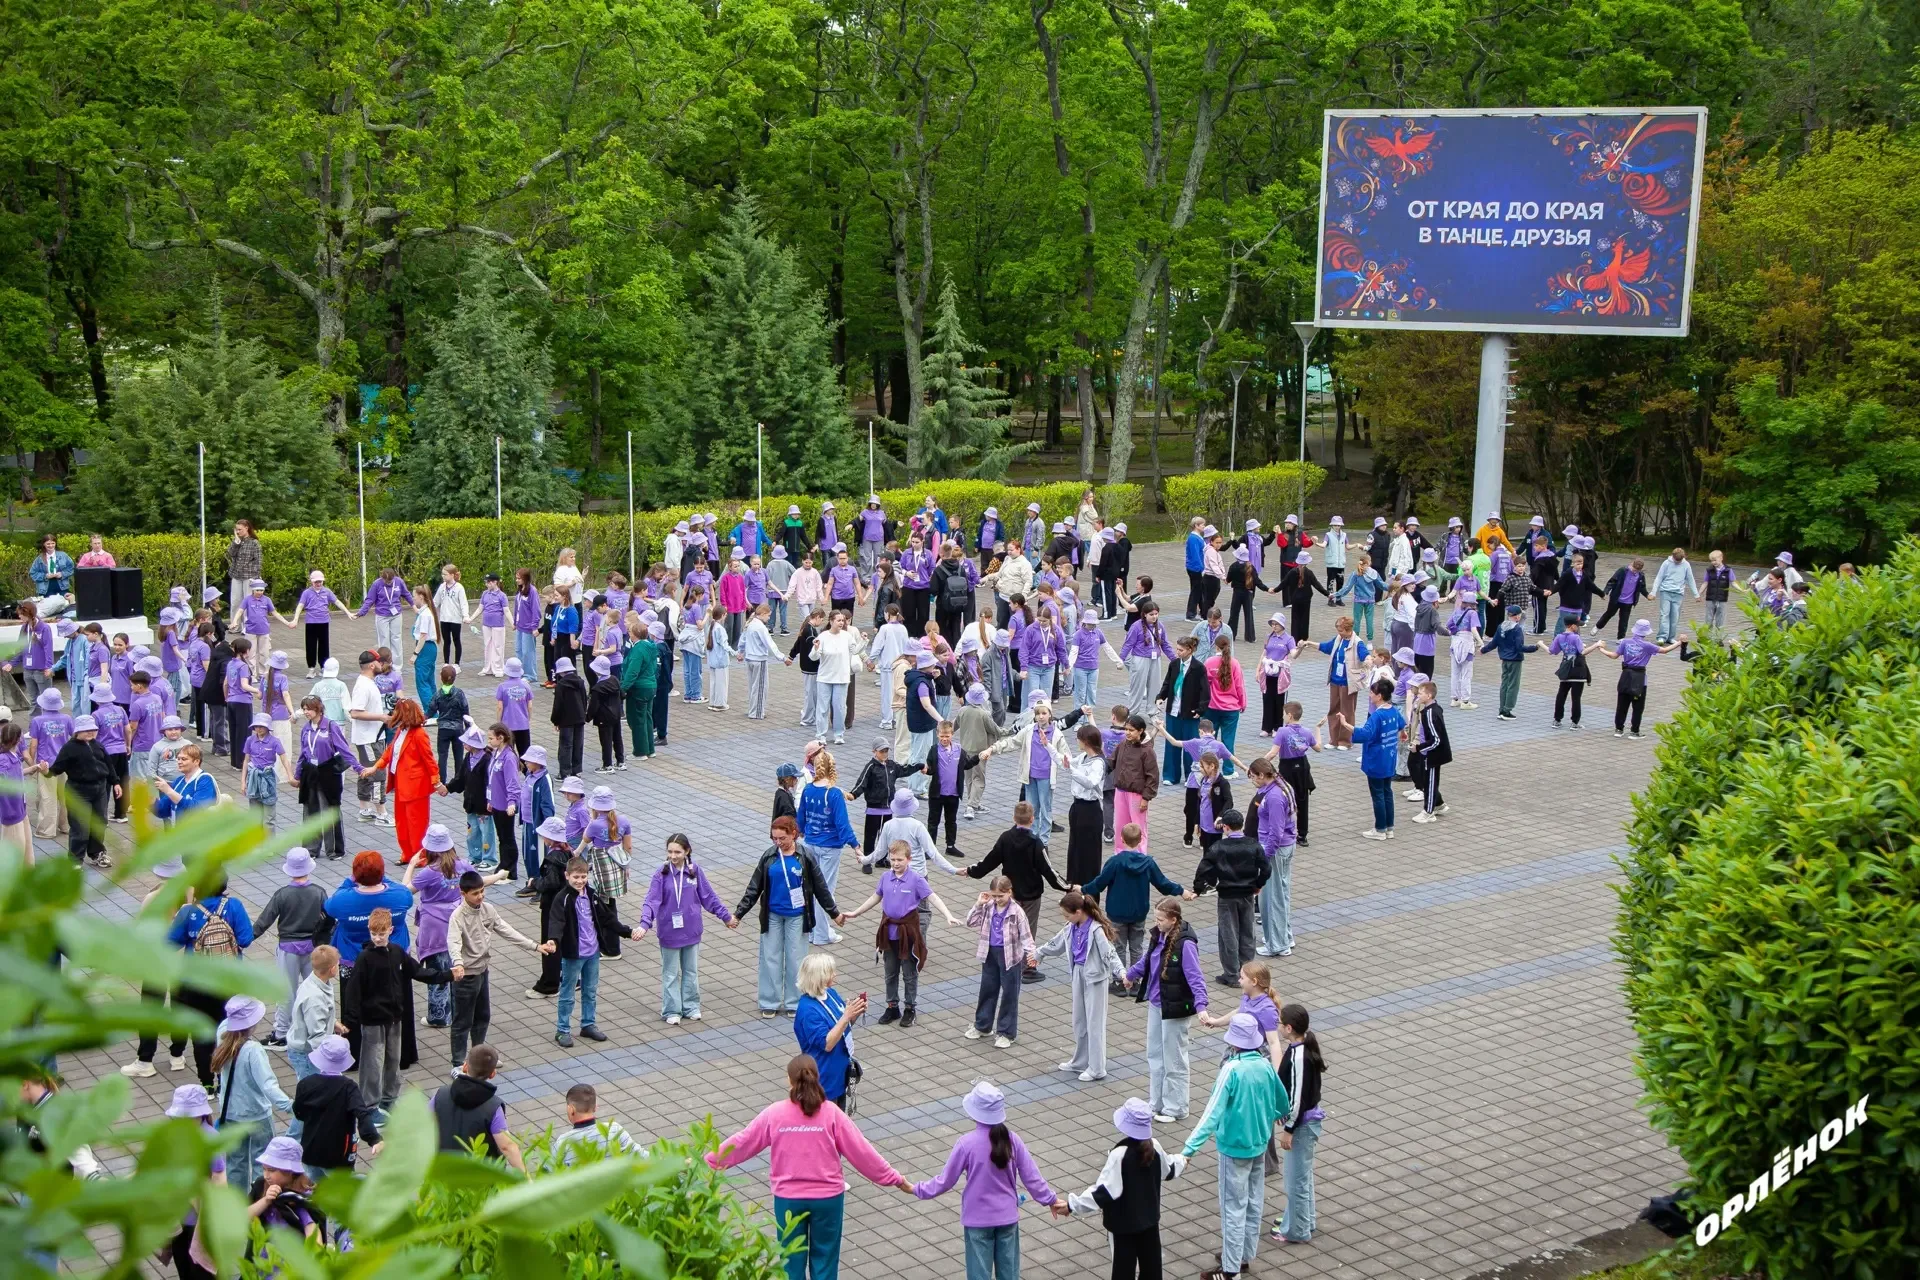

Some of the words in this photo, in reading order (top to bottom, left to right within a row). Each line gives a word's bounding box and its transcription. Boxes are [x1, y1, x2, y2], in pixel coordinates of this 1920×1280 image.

[1408, 200, 1439, 218] ОТ
[1443, 200, 1500, 219] КРАЯ
[1505, 201, 1540, 221] ДО
[1545, 201, 1604, 220] КРАЯ
[1418, 226, 1432, 243] В
[1437, 227, 1508, 247] ТАНЦЕ,
[1510, 228, 1591, 247] ДРУЗЬЯ
[778, 1124, 825, 1133] ОРЛЁНОК
